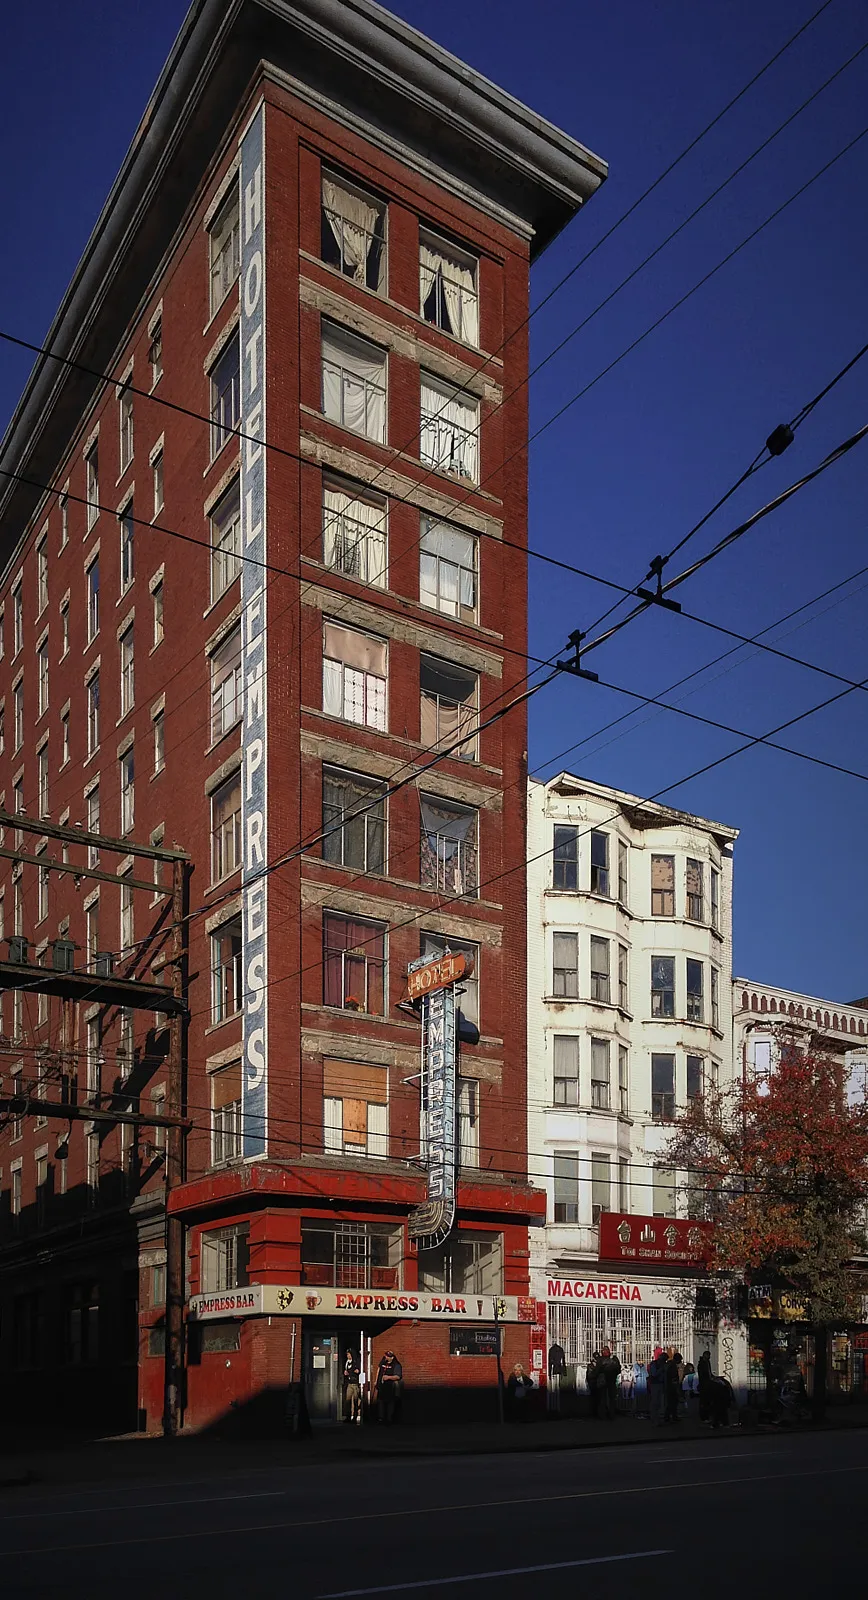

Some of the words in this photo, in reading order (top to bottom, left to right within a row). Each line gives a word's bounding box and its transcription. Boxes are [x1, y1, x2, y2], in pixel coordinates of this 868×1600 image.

[245, 162, 262, 549] HOTEL
[246, 585, 264, 1091] EMPRESS
[409, 958, 461, 996] HOTEL
[428, 996, 445, 1199] EMPRESS
[199, 1296, 236, 1314] EMPRESS
[236, 1293, 254, 1309] BAR
[335, 1293, 419, 1312] EMPRESS
[431, 1297, 467, 1314] BAR
[547, 1279, 643, 1302] MACARENA
[748, 1284, 772, 1300] ATM
